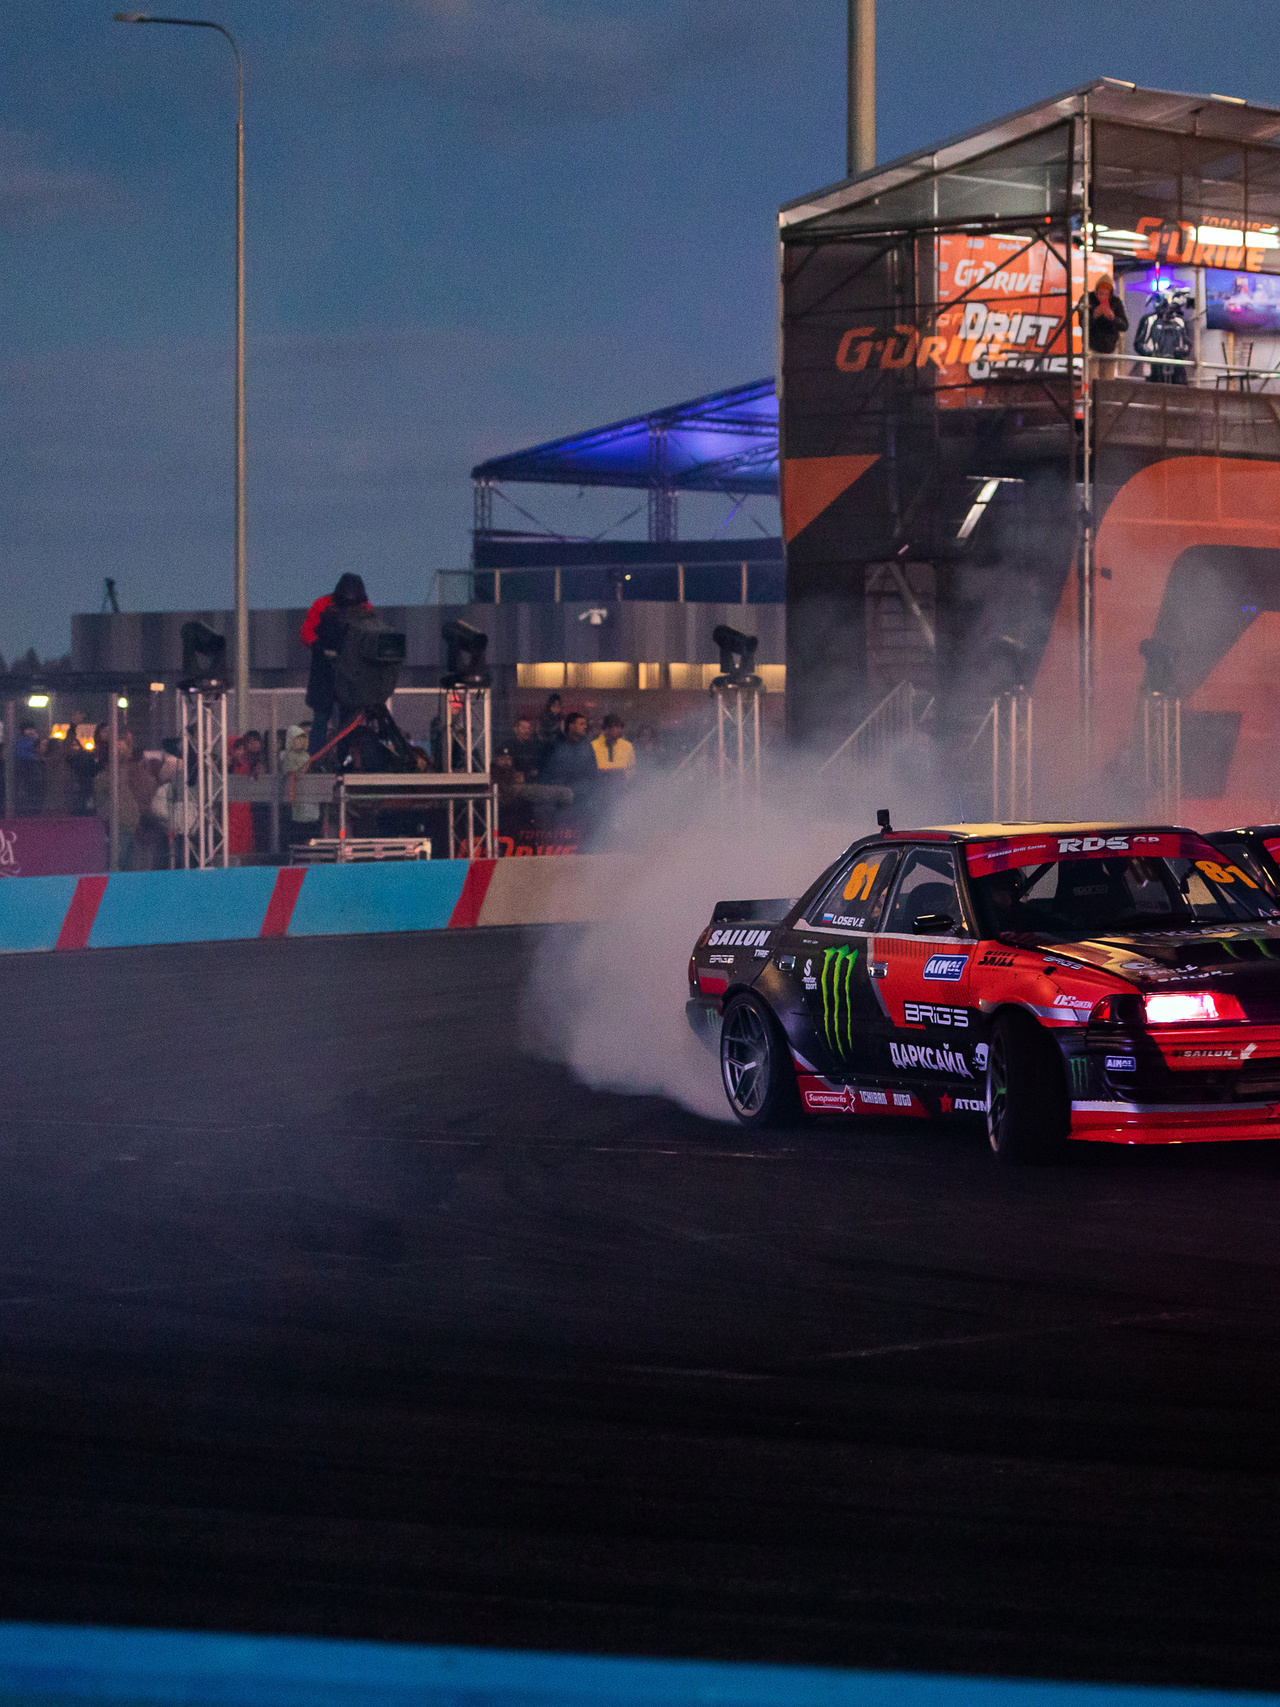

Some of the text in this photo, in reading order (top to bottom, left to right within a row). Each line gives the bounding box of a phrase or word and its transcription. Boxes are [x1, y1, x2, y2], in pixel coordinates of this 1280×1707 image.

[958, 302, 1059, 346] DRIFT
[1057, 836, 1130, 853] RDS
[843, 863, 880, 900] 81
[1195, 860, 1259, 888] 81
[708, 930, 771, 946] SAILUN
[1053, 994, 1077, 1006] OS
[889, 1042, 974, 1079] ДАРКСАЙД
